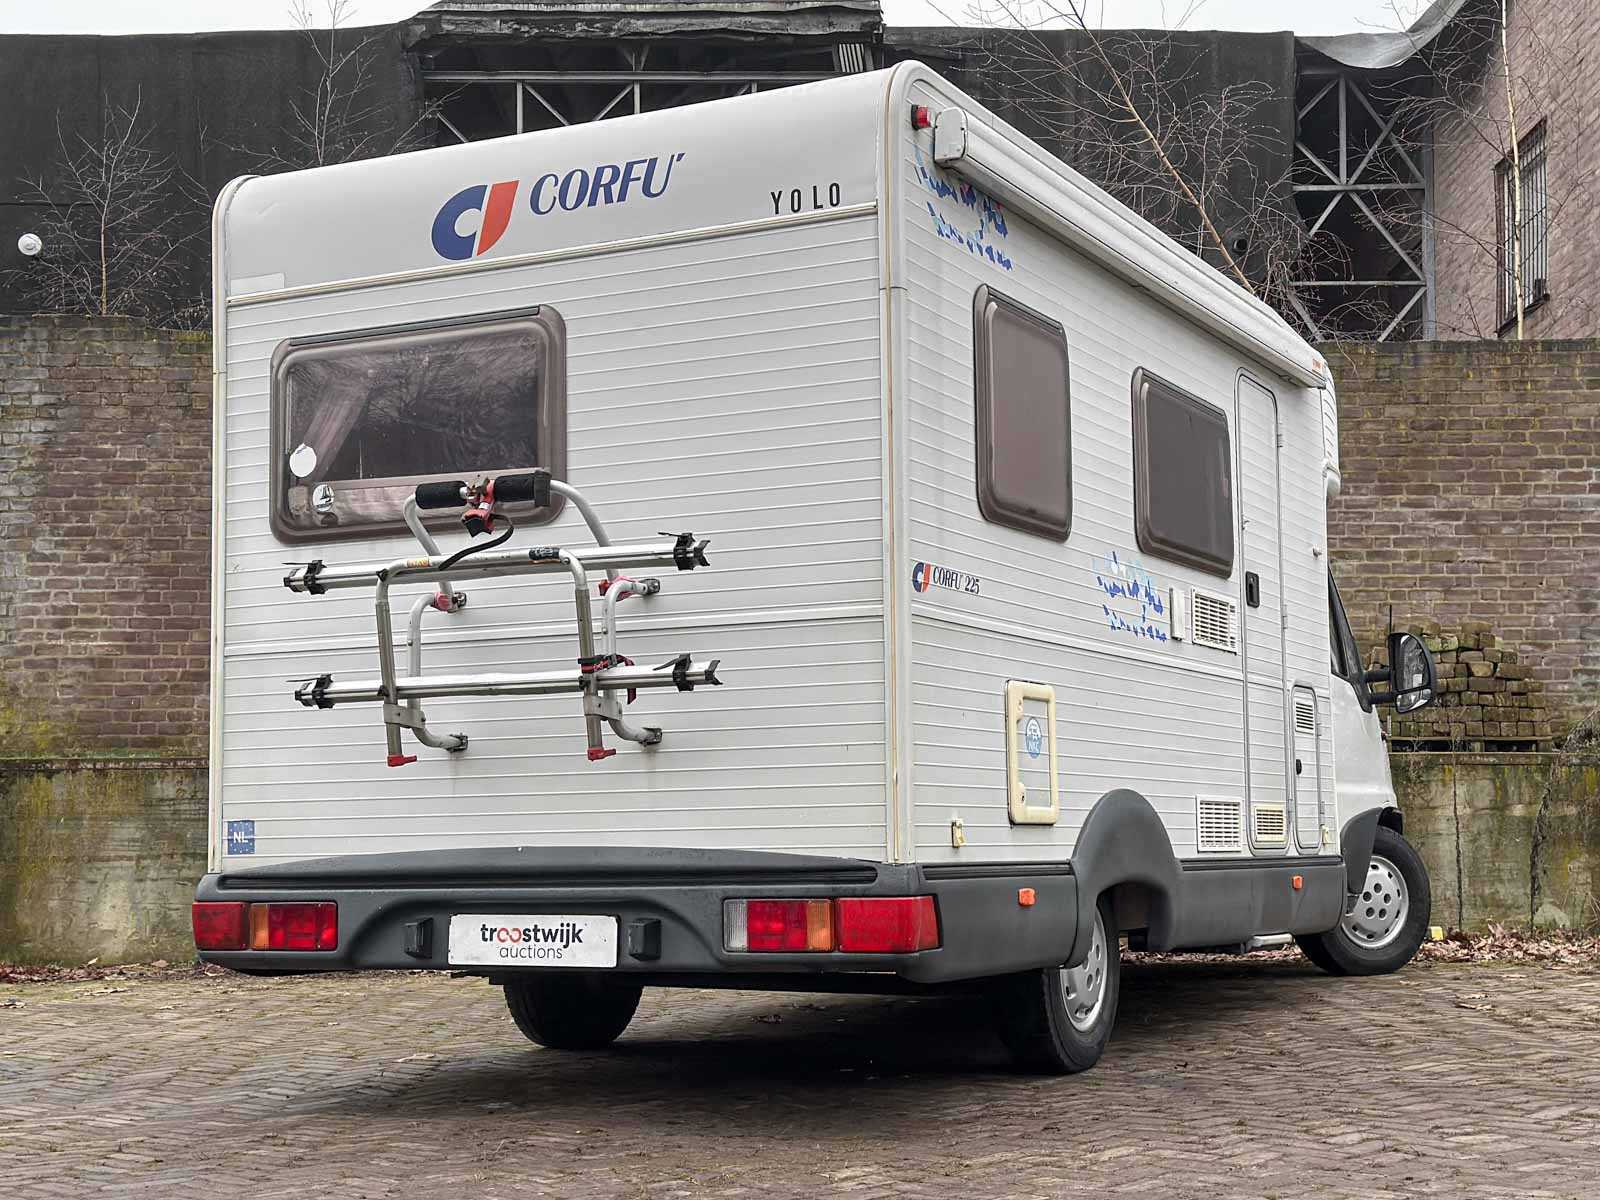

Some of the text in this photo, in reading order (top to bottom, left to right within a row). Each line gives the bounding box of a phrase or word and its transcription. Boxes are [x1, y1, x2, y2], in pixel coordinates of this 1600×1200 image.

[770, 182, 841, 215] YOLO
[964, 575, 980, 595] 225
[233, 831, 249, 843] NL
[480, 922, 584, 949] troostwijk
[499, 944, 563, 959] auctions
